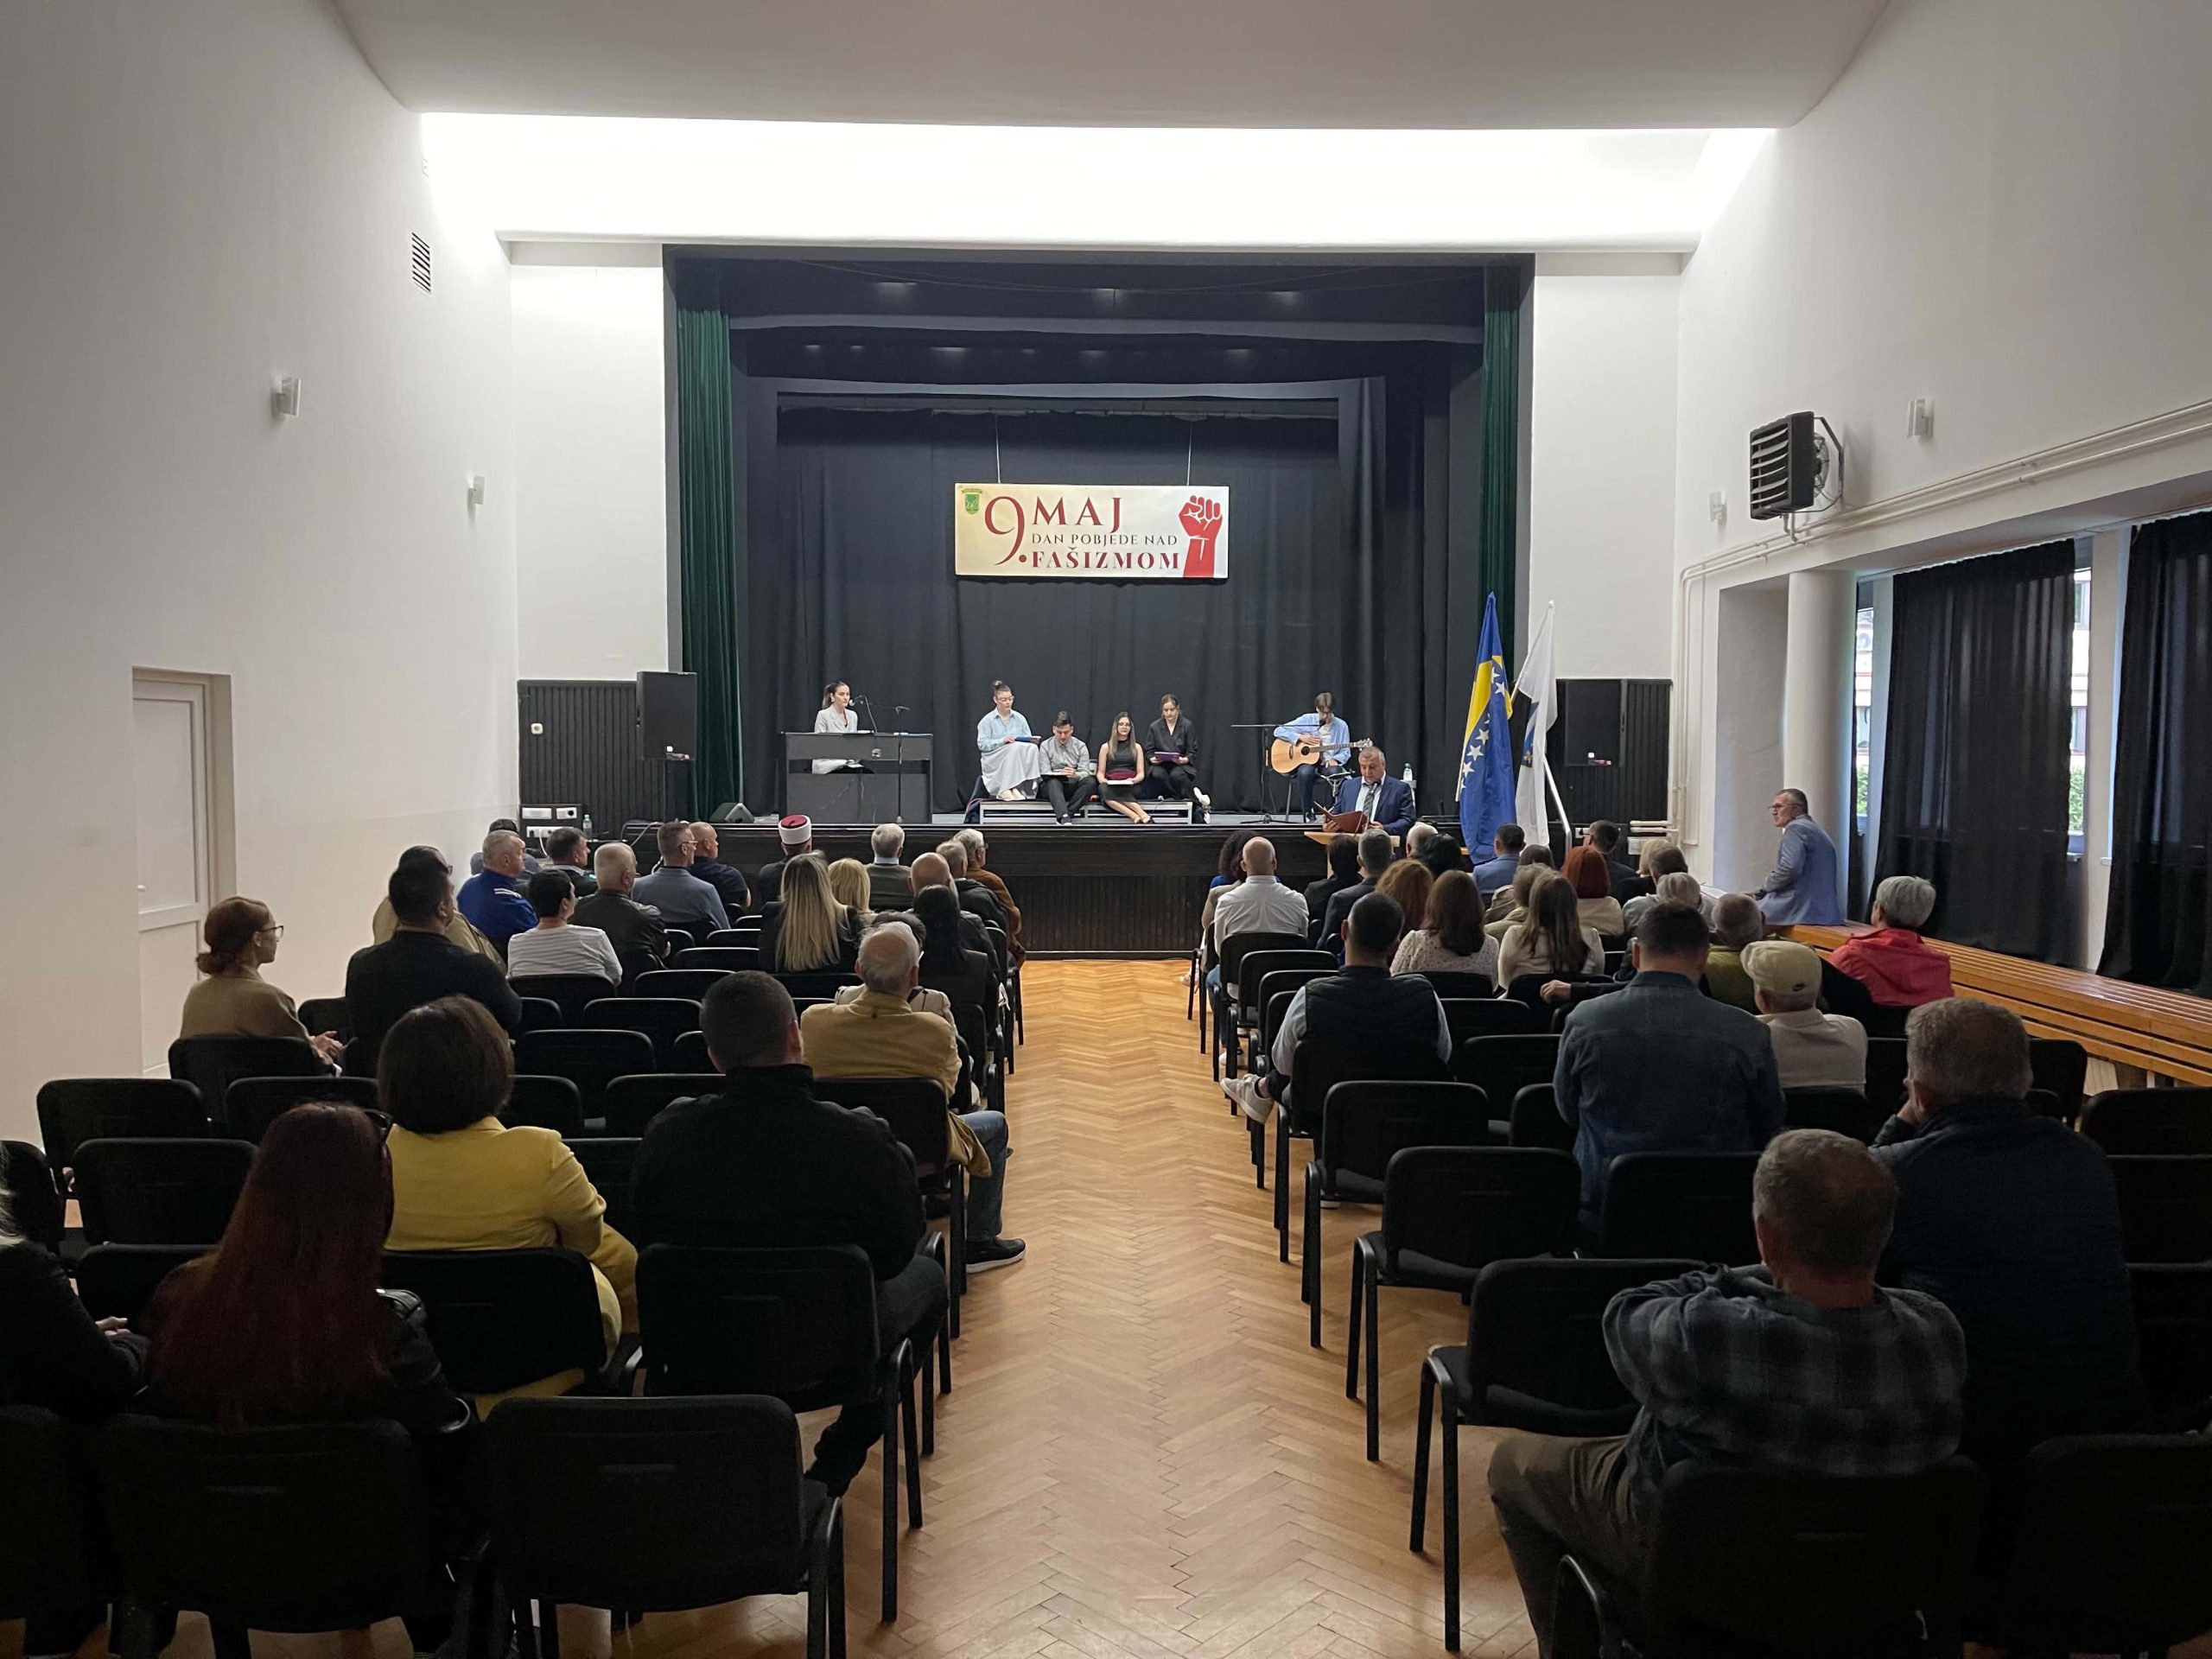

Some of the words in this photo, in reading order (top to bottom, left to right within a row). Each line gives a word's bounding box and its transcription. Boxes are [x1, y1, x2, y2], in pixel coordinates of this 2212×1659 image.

[1032, 496, 1122, 533] MAJ
[1032, 533, 1064, 544] DAN
[1071, 533, 1138, 547] POBJEDE
[1145, 535, 1177, 546] NAD
[1032, 546, 1179, 569] FAŠIZMOM
